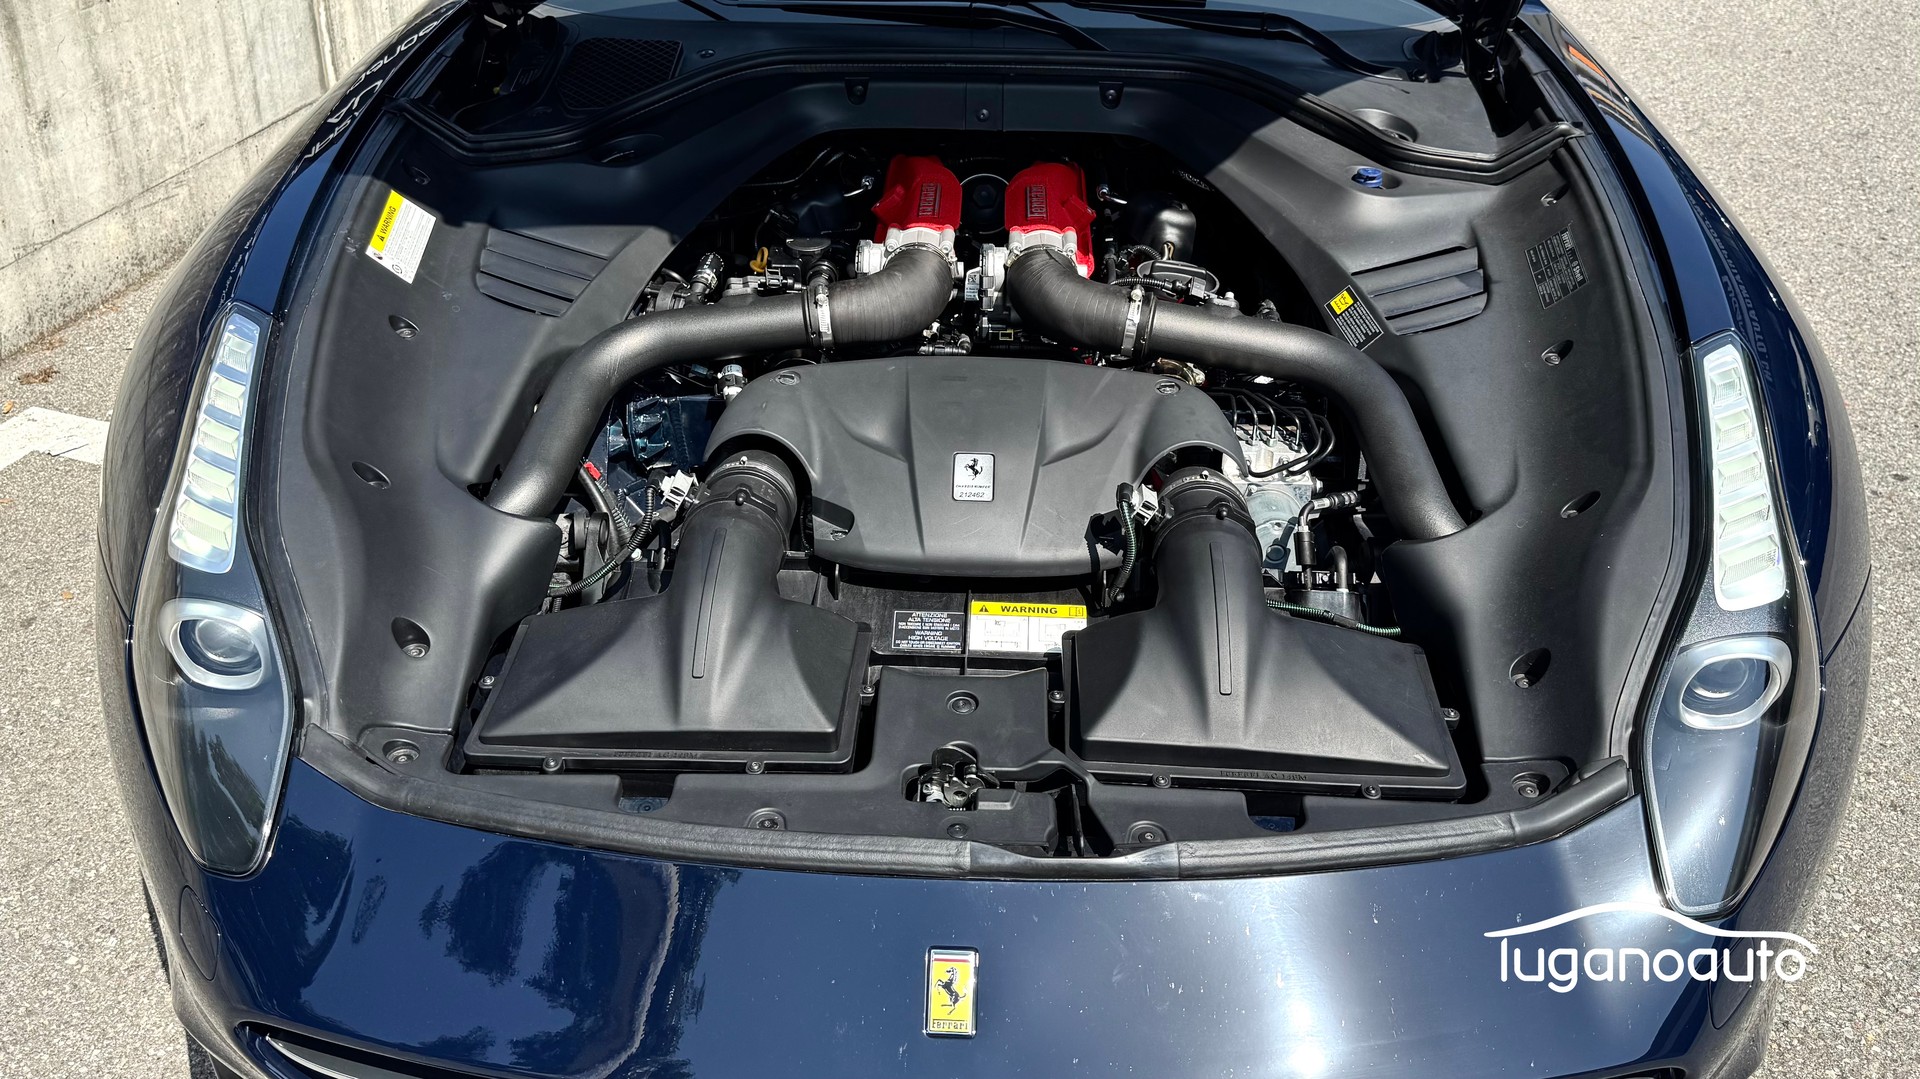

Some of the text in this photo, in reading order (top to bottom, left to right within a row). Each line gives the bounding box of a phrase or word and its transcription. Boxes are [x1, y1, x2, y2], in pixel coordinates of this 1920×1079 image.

[380, 205, 397, 235] WARNING
[1000, 605, 1058, 614] WARNING
[932, 1018, 968, 1030] Ferrari
